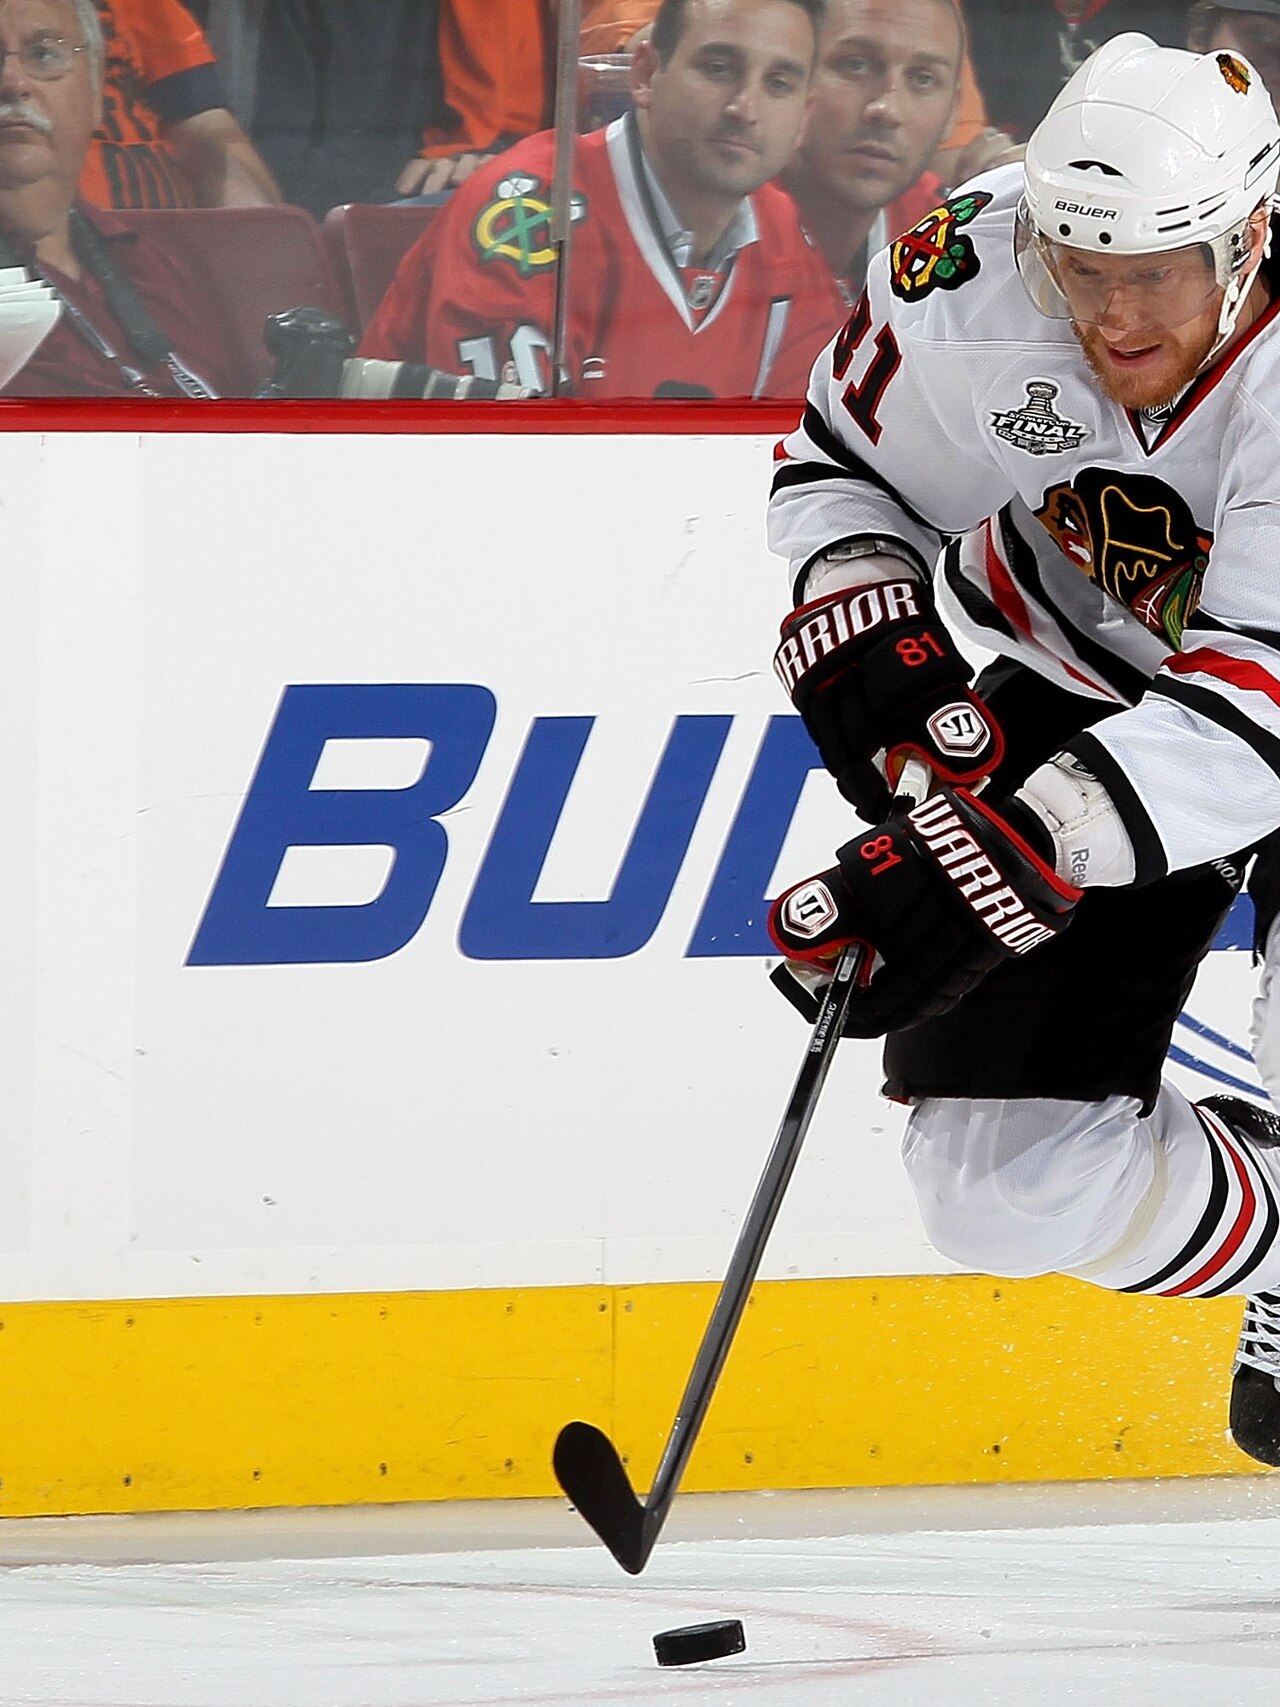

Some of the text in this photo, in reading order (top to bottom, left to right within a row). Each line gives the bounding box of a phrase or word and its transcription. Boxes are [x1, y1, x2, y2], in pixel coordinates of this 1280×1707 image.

[995, 416, 1082, 439] FINAL
[774, 583, 920, 697] RRIOR
[895, 631, 946, 668] 81
[859, 834, 904, 877] 81
[1071, 847, 1089, 887] Ree
